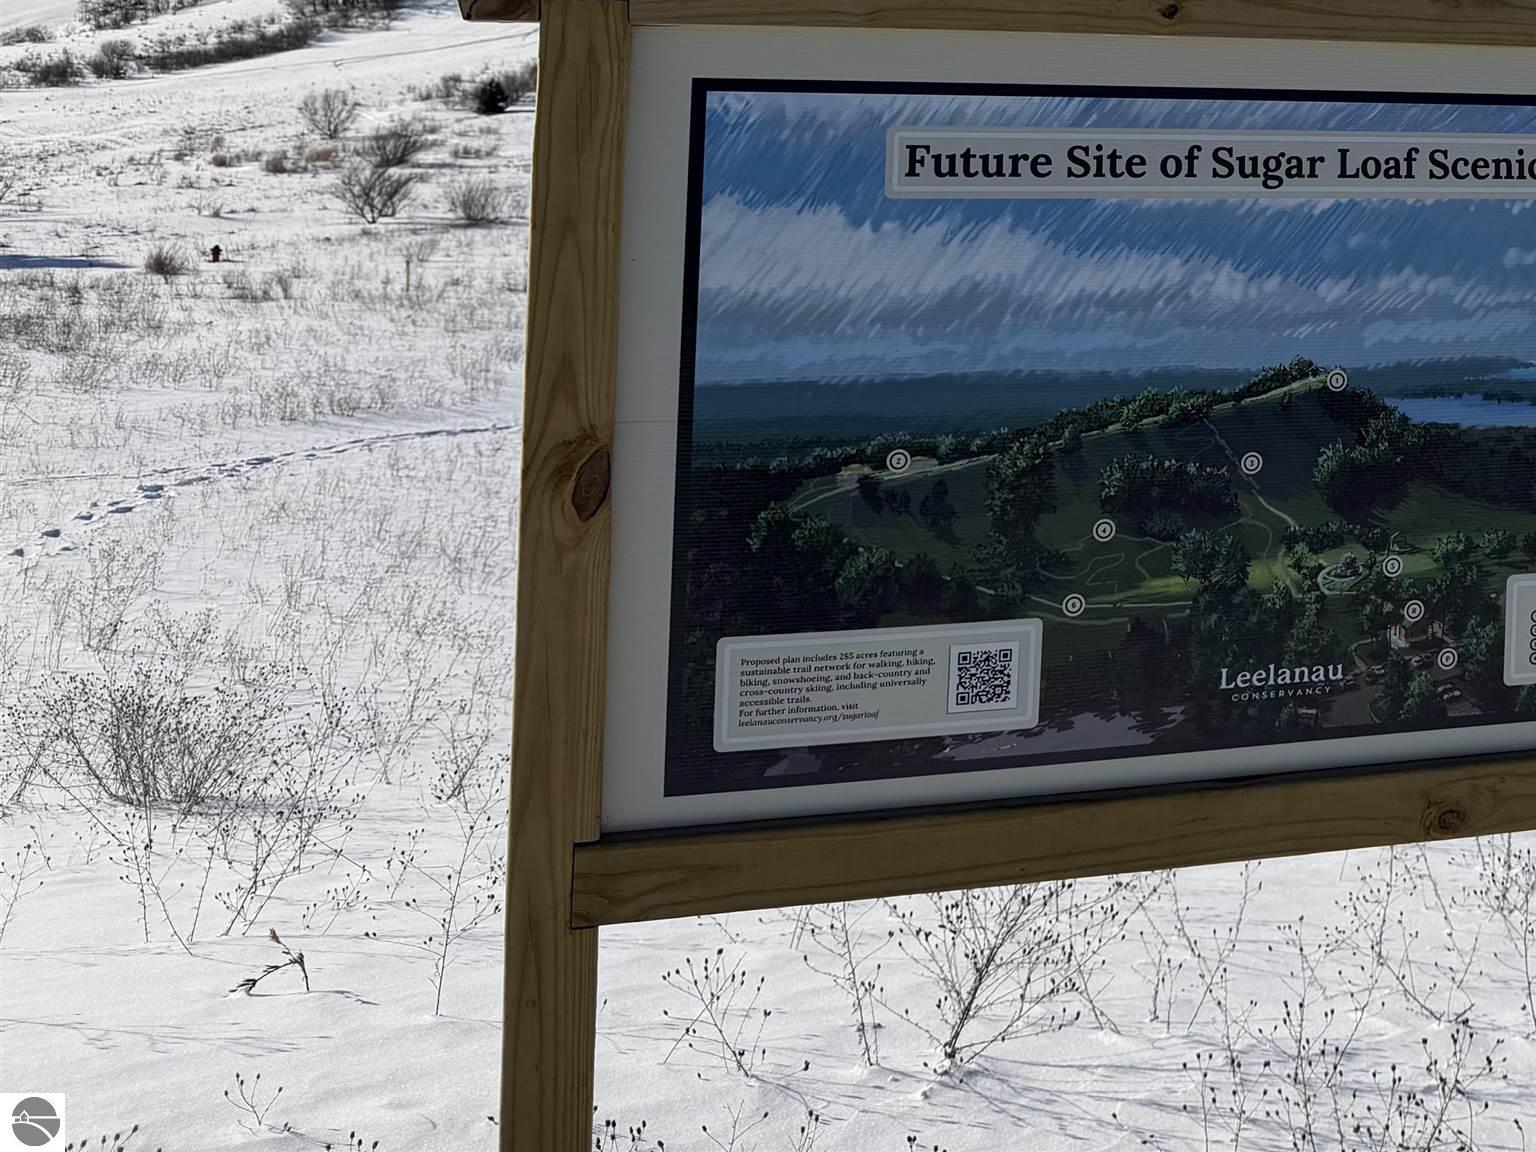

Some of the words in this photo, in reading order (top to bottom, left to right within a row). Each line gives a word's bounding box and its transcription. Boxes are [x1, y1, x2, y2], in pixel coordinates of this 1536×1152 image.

[904, 144, 1053, 179] Future
[1066, 143, 1147, 179] Site
[1159, 144, 1202, 178] of
[1211, 146, 1325, 190] Sugar
[1337, 147, 1420, 180] Loaf
[740, 667, 791, 677] sustainable
[793, 665, 812, 673] trail
[813, 662, 851, 672] network
[852, 661, 866, 670] for
[868, 659, 904, 668] walking,
[906, 657, 936, 666] hiking,
[741, 656, 781, 667] Proposed
[782, 655, 801, 665] plan
[802, 653, 837, 663] includes
[855, 652, 878, 660] acres
[880, 648, 918, 658] featuring
[740, 678, 771, 688] biking,
[772, 674, 833, 685] snowshoeing,
[835, 672, 851, 681] and
[853, 668, 912, 679] back-country
[914, 667, 931, 676] and
[1220, 663, 1343, 689] Leelanau
[739, 686, 802, 697] cross-country
[805, 684, 834, 693] skiing,
[836, 680, 878, 690] including
[879, 677, 927, 687] universally
[1231, 686, 1331, 702] CONSERVANCY
[739, 696, 785, 707] accessible
[739, 709, 754, 717] For
[755, 707, 786, 716] further
[787, 703, 840, 714] information,
[841, 702, 859, 710] visit
